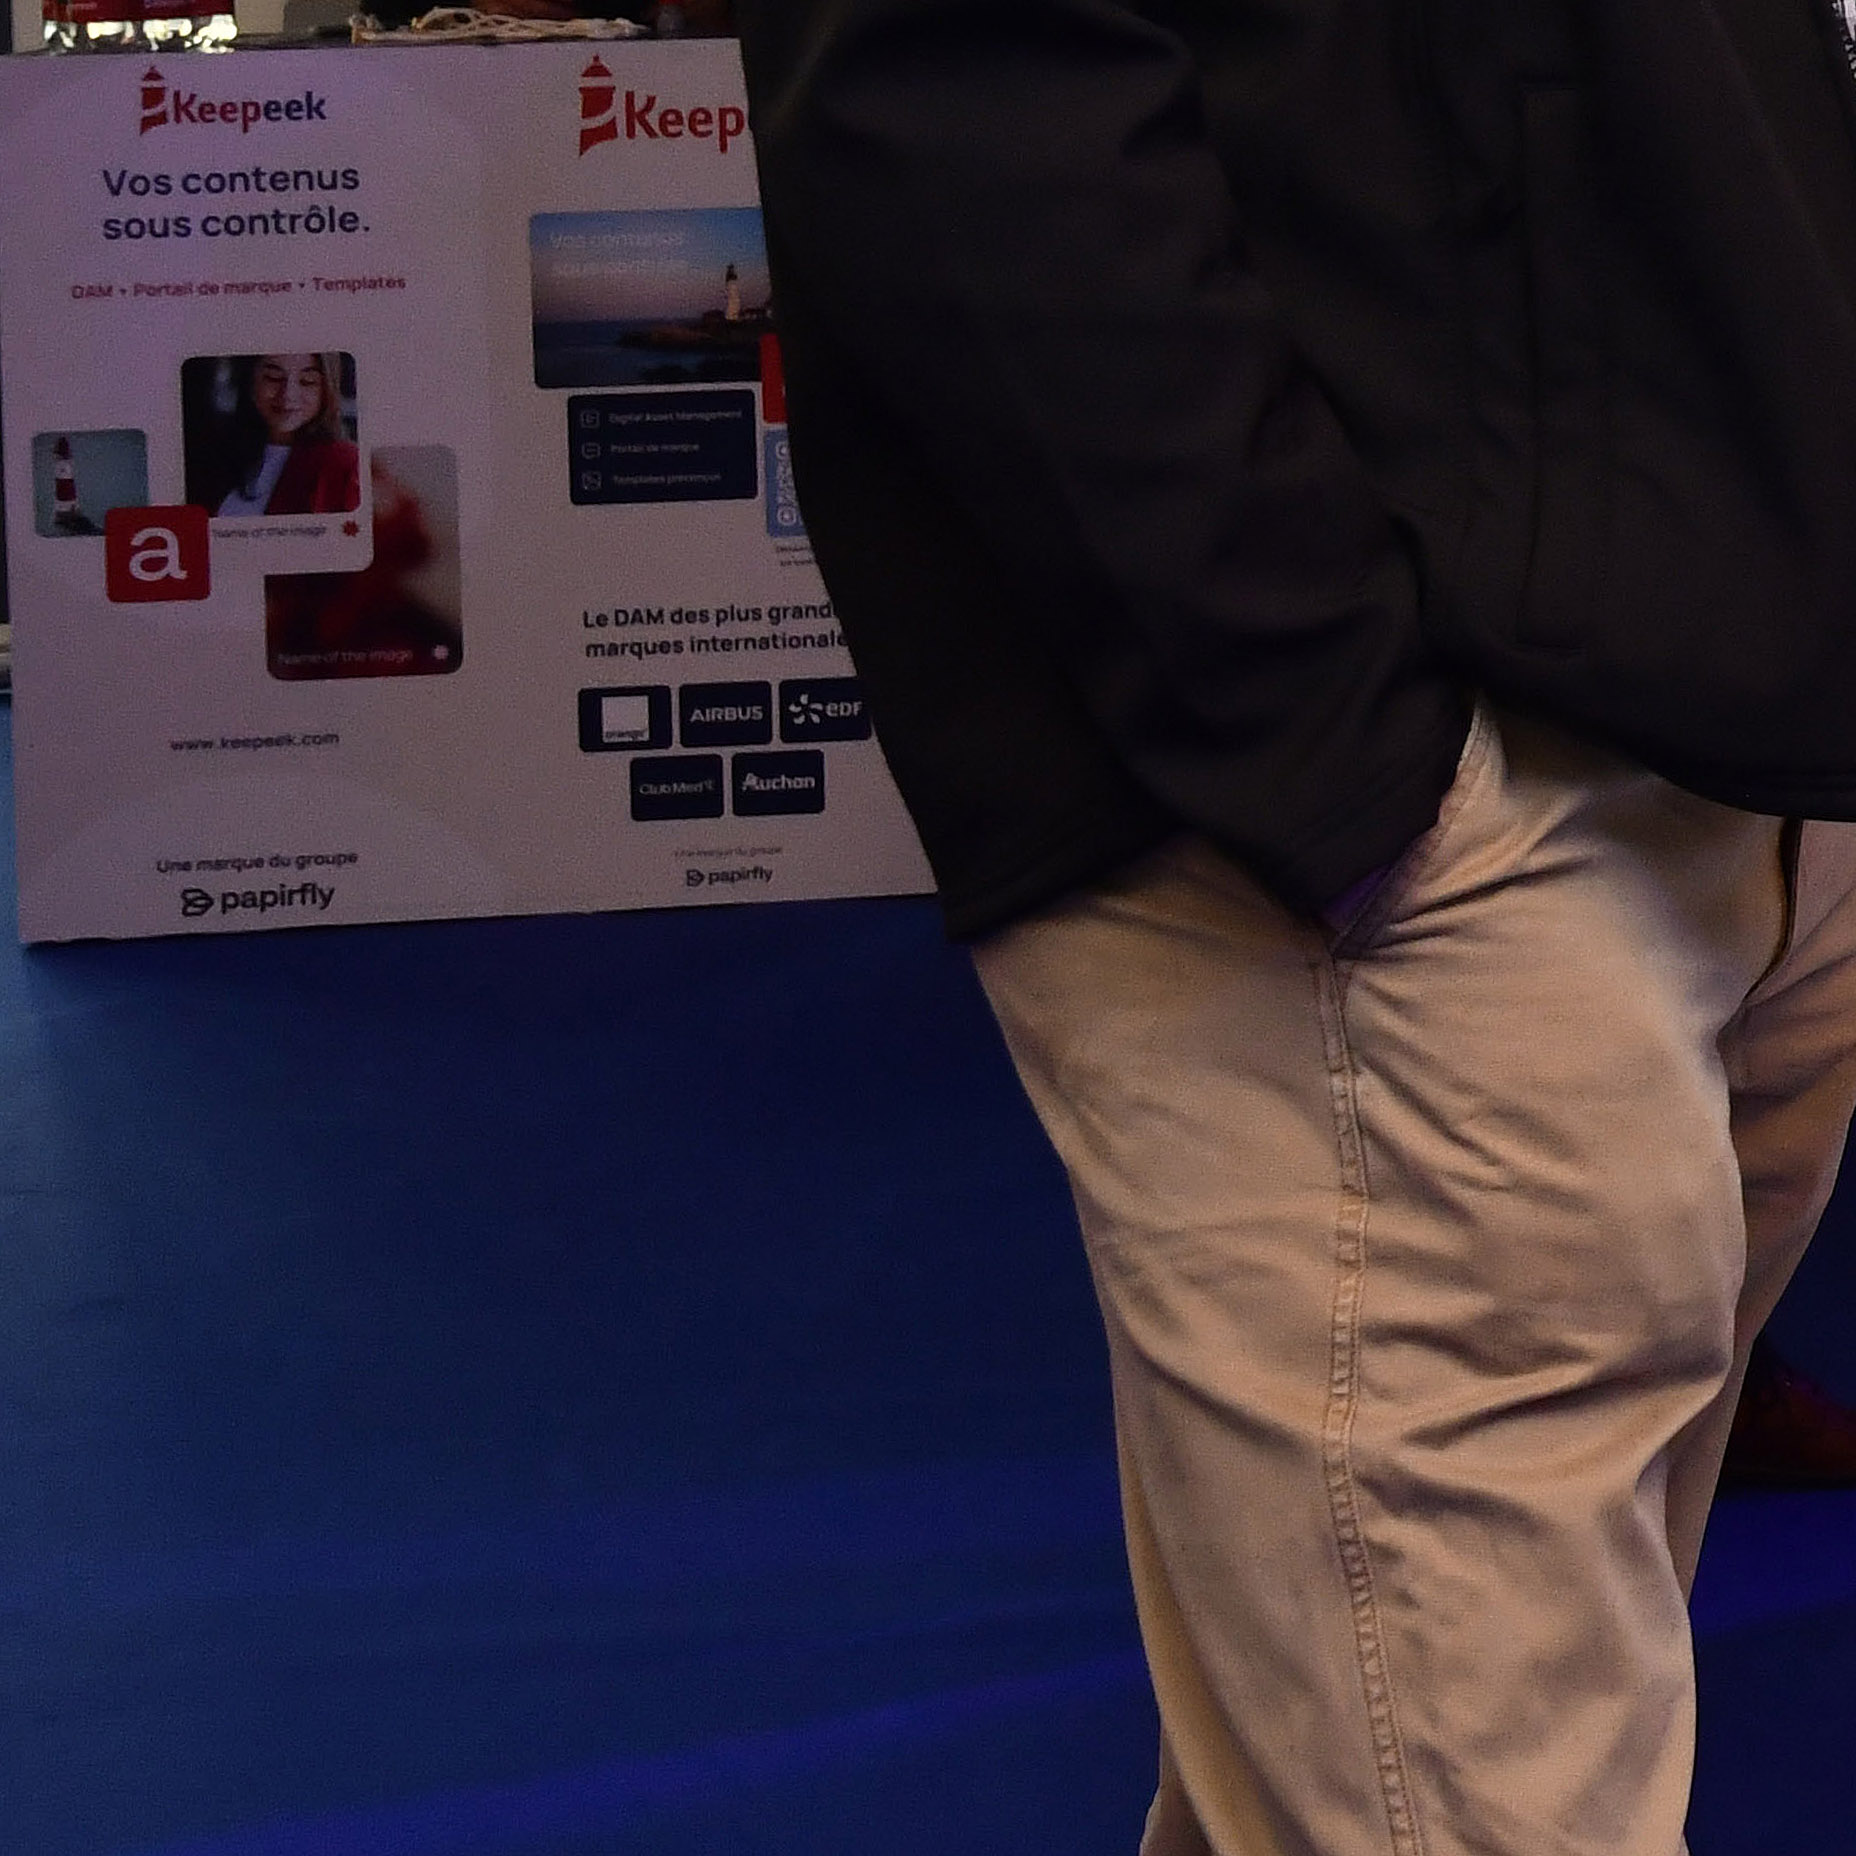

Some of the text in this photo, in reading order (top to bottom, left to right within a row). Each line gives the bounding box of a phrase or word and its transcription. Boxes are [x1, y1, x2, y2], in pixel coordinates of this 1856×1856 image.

[172, 89, 328, 135] Keepeek
[624, 90, 746, 155] Keep
[102, 165, 361, 198] Vos contenus
[102, 204, 371, 241] sous contrôle.
[133, 280, 195, 299] Portail
[199, 278, 220, 296] de
[312, 274, 408, 294] Templates
[129, 525, 188, 582] a
[582, 609, 608, 630] Le
[613, 607, 665, 628] DAM
[669, 606, 711, 625] des
[715, 603, 763, 628] plus
[585, 638, 685, 661] marques
[689, 705, 764, 724] AIRBUS
[741, 771, 817, 792] Auchan
[155, 851, 360, 876] Une marque du groupe
[707, 865, 774, 886] papirfly
[220, 882, 336, 915] papirfly
